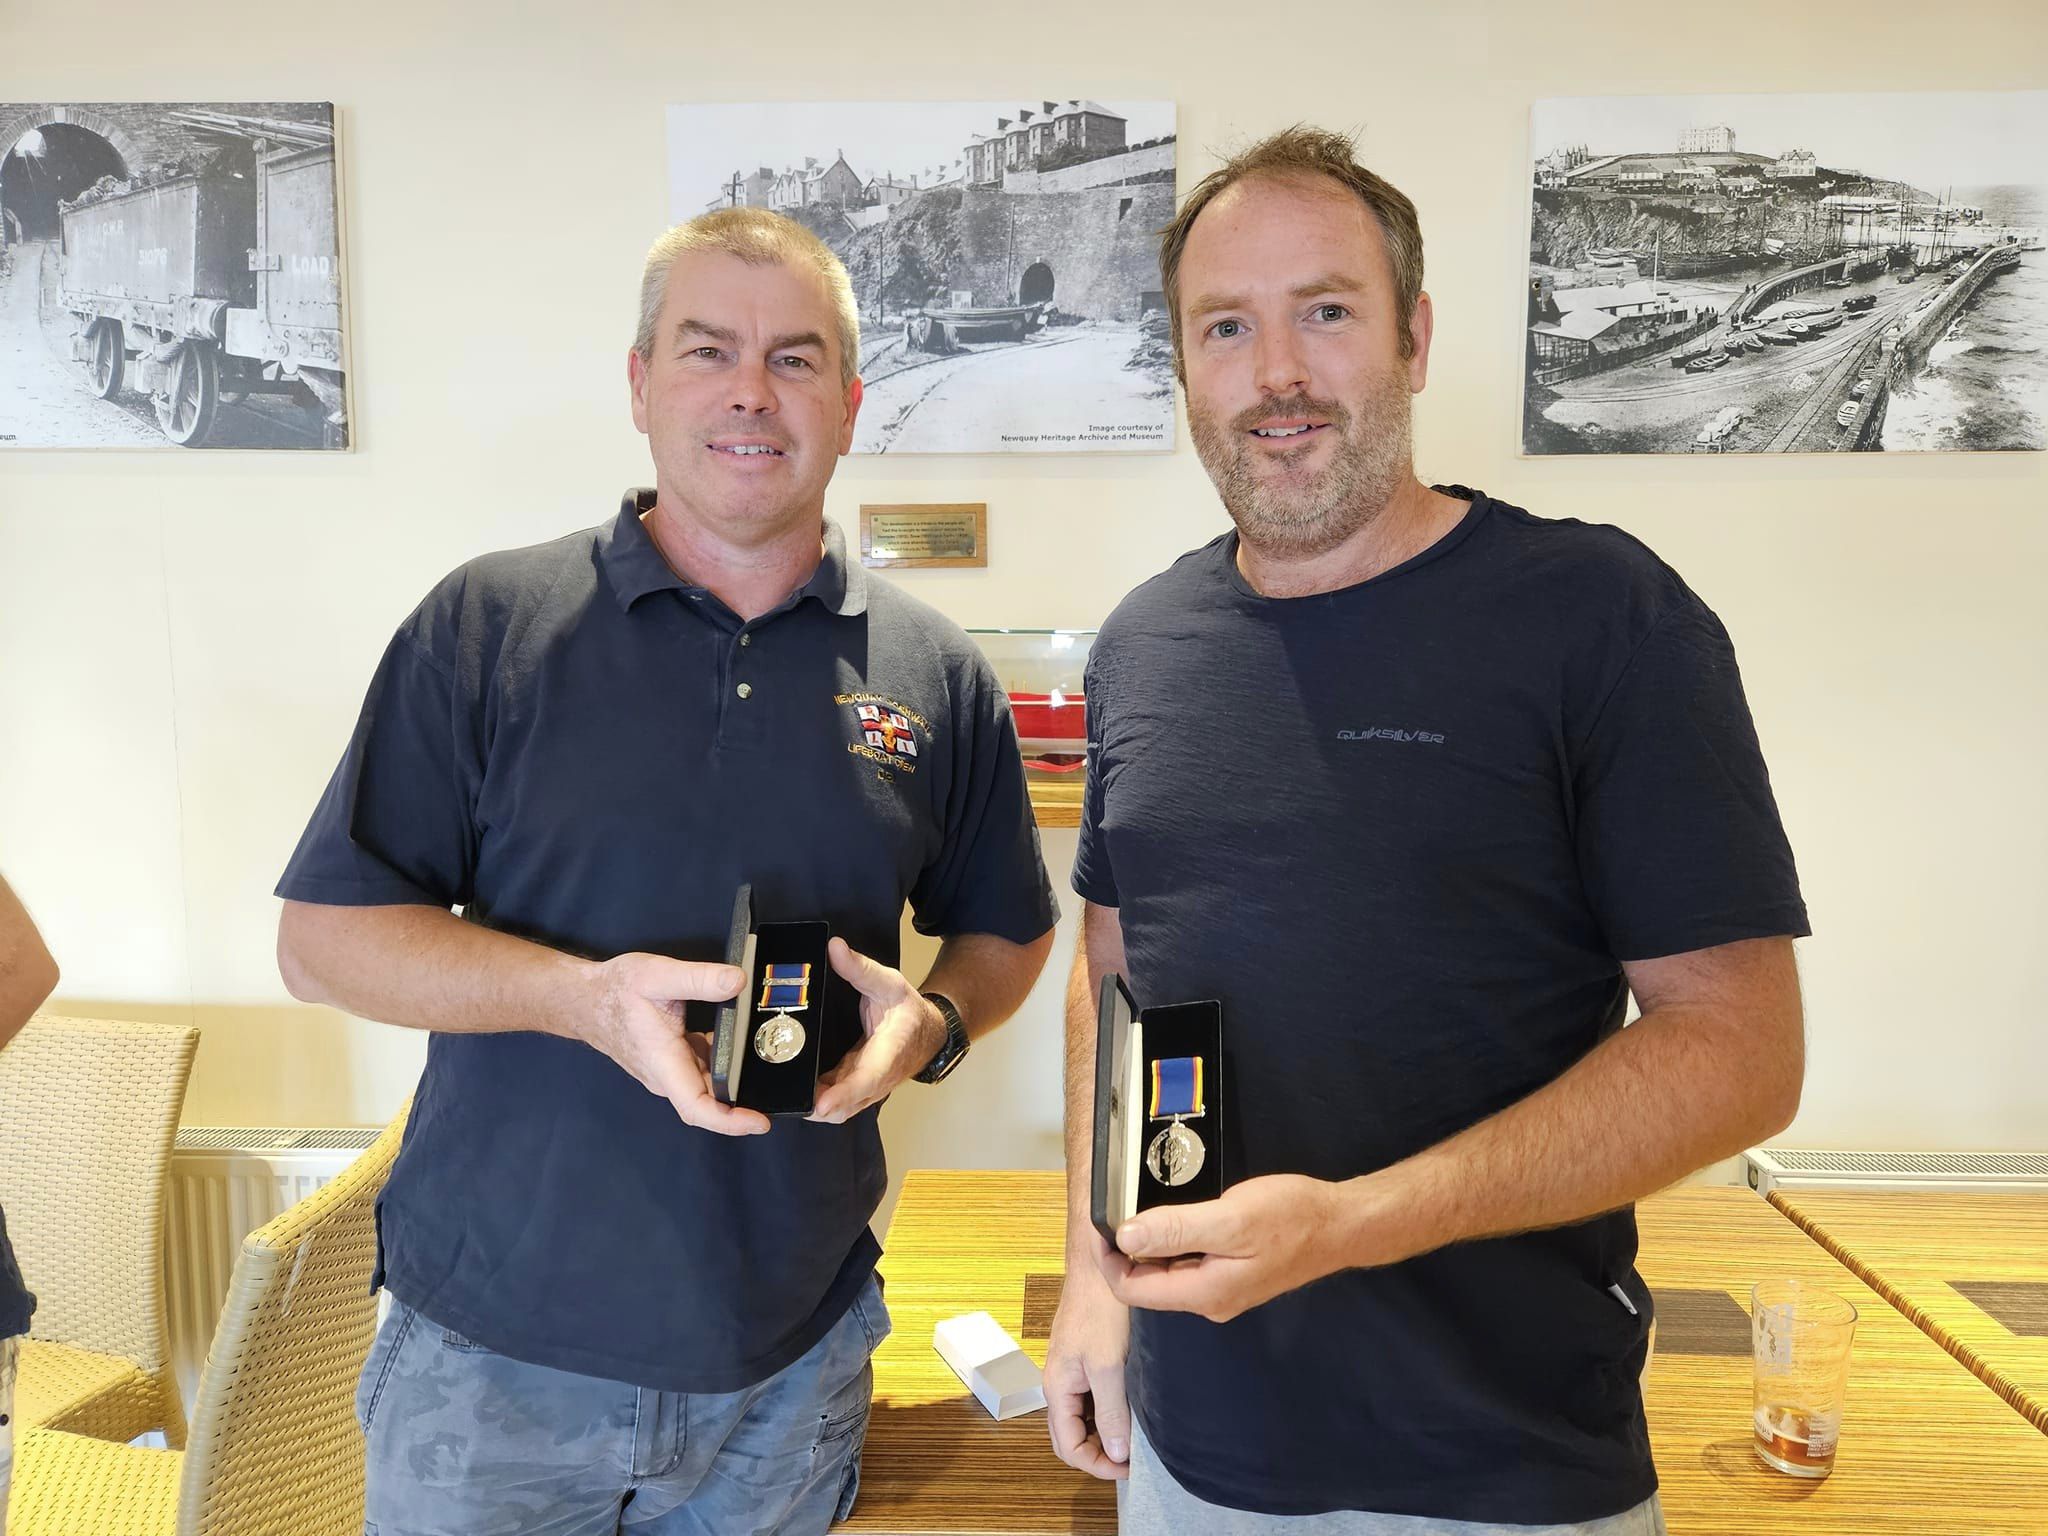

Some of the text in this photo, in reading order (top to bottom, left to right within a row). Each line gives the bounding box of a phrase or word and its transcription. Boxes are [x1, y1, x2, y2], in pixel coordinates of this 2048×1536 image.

[291, 254, 330, 275] LOAD
[1088, 424, 1115, 433] Image
[1117, 424, 1153, 433] courtesy
[1001, 434, 1039, 443] Newquay
[1041, 434, 1076, 442] Heritage
[1111, 433, 1127, 441] and
[1129, 433, 1164, 441] Museum
